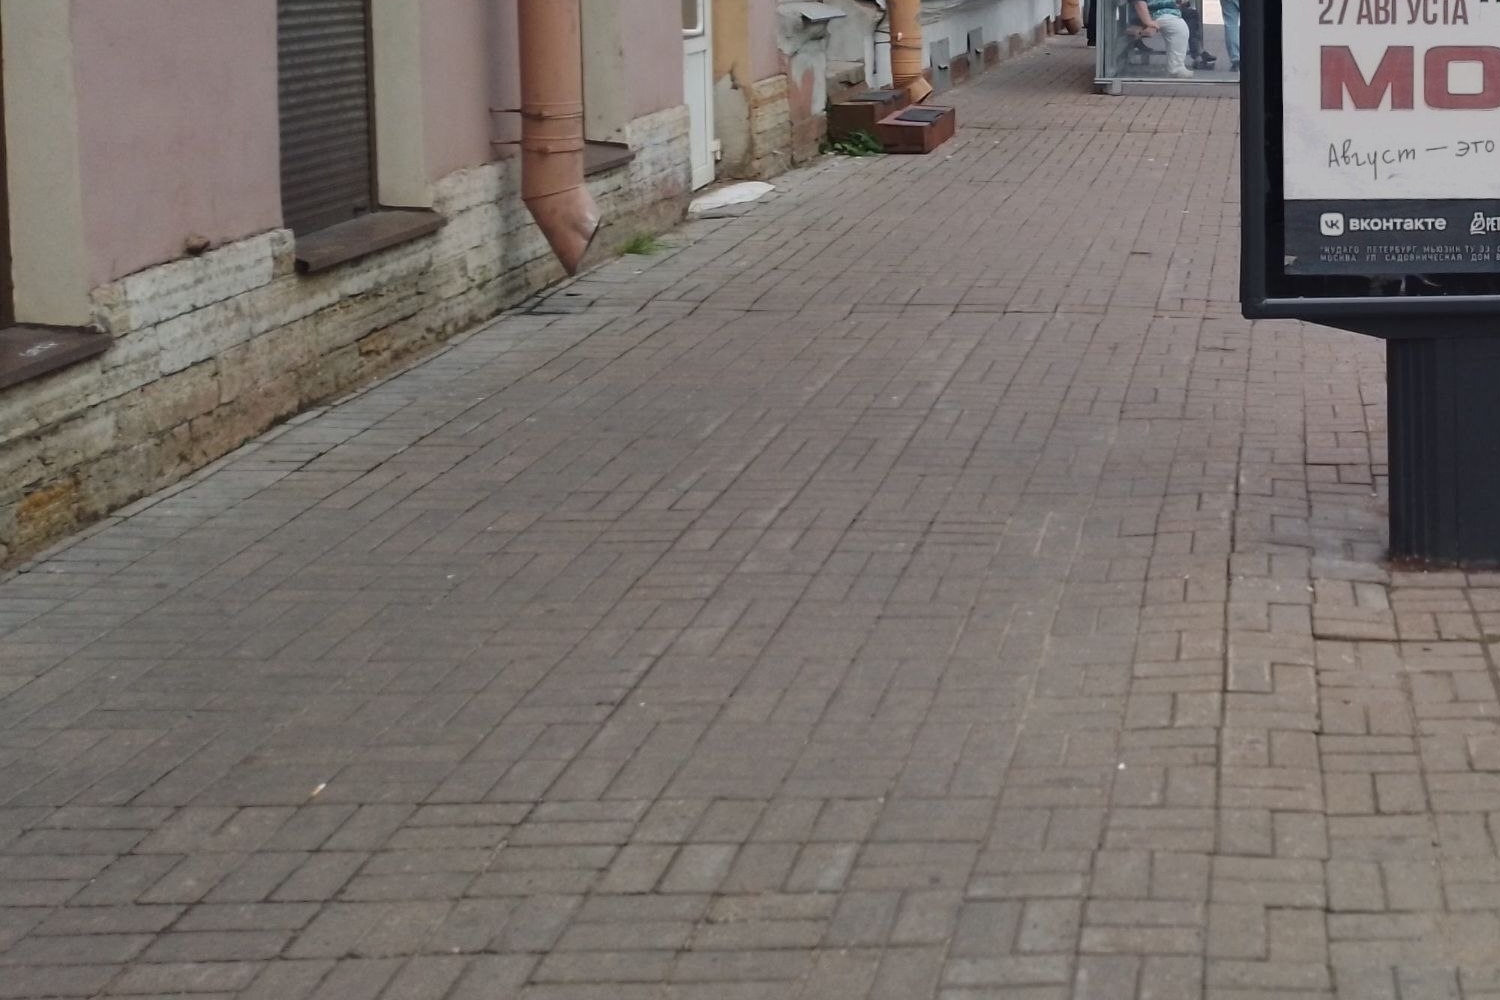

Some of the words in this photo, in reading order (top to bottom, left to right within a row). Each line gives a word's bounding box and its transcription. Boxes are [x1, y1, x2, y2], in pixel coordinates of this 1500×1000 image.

[1328, 139, 1416, 180] Август
[1455, 140, 1495, 157] это
[1471, 253, 1490, 261] ДОМ
